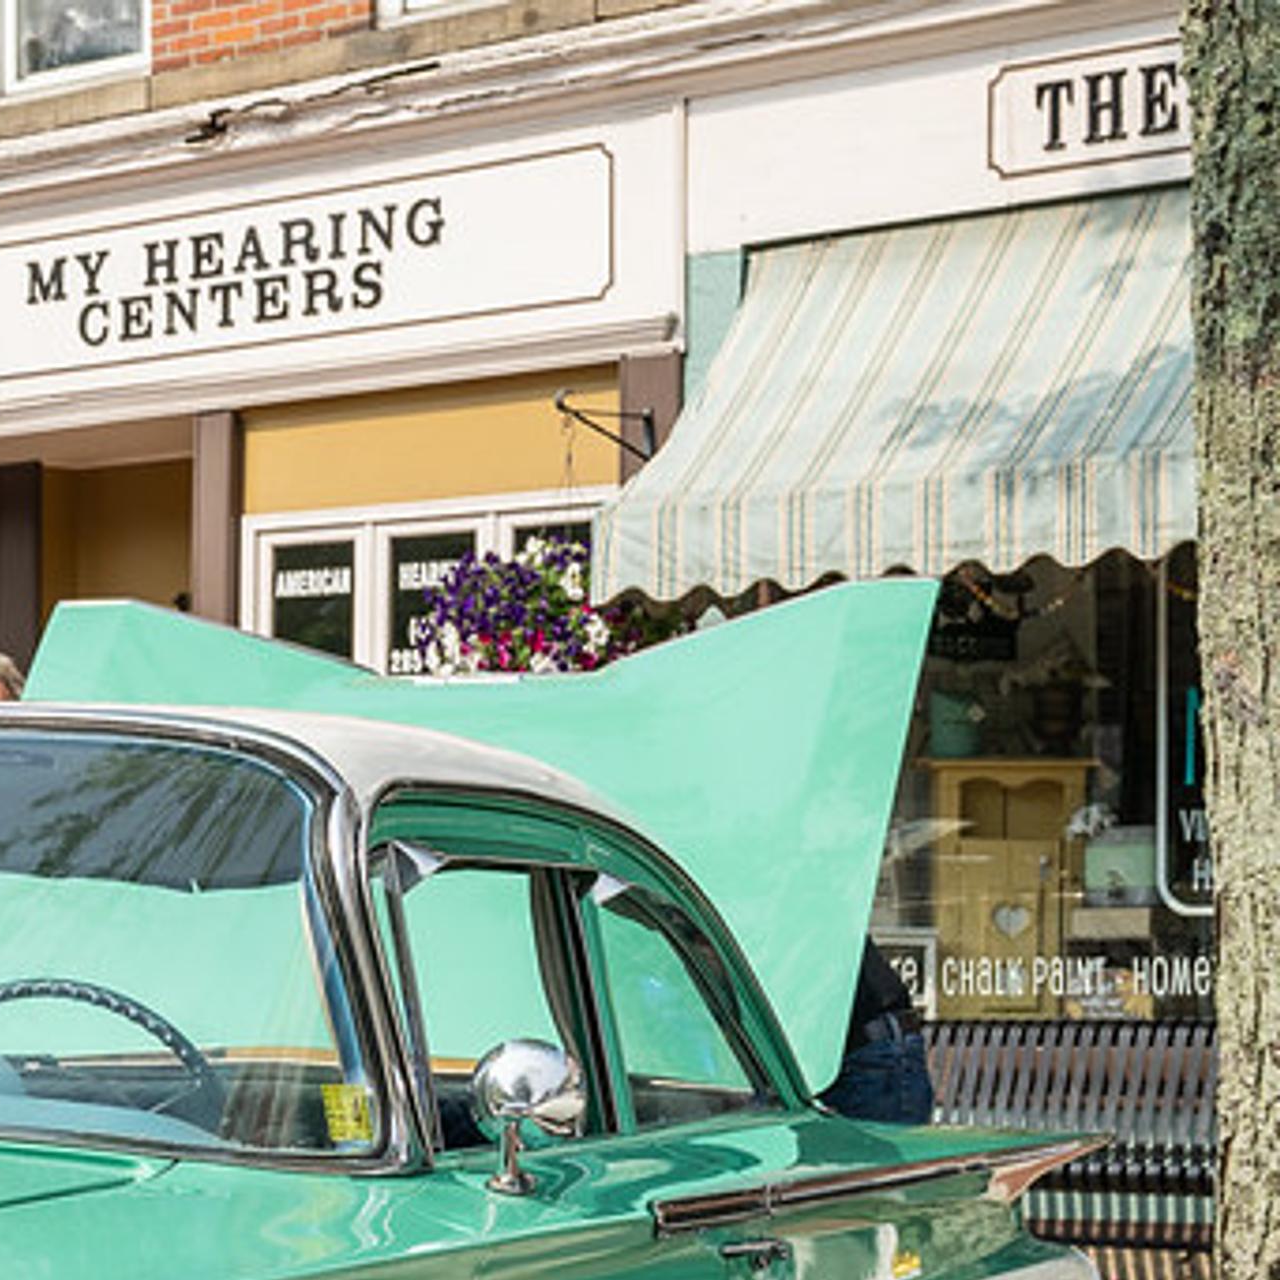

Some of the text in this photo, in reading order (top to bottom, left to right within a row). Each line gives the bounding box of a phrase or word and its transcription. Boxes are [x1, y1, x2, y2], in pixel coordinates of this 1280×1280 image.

[1035, 62, 1179, 152] THE
[26, 197, 446, 305] MY HEARING
[78, 261, 386, 346] CENTERS
[274, 566, 352, 599] AMERICAN
